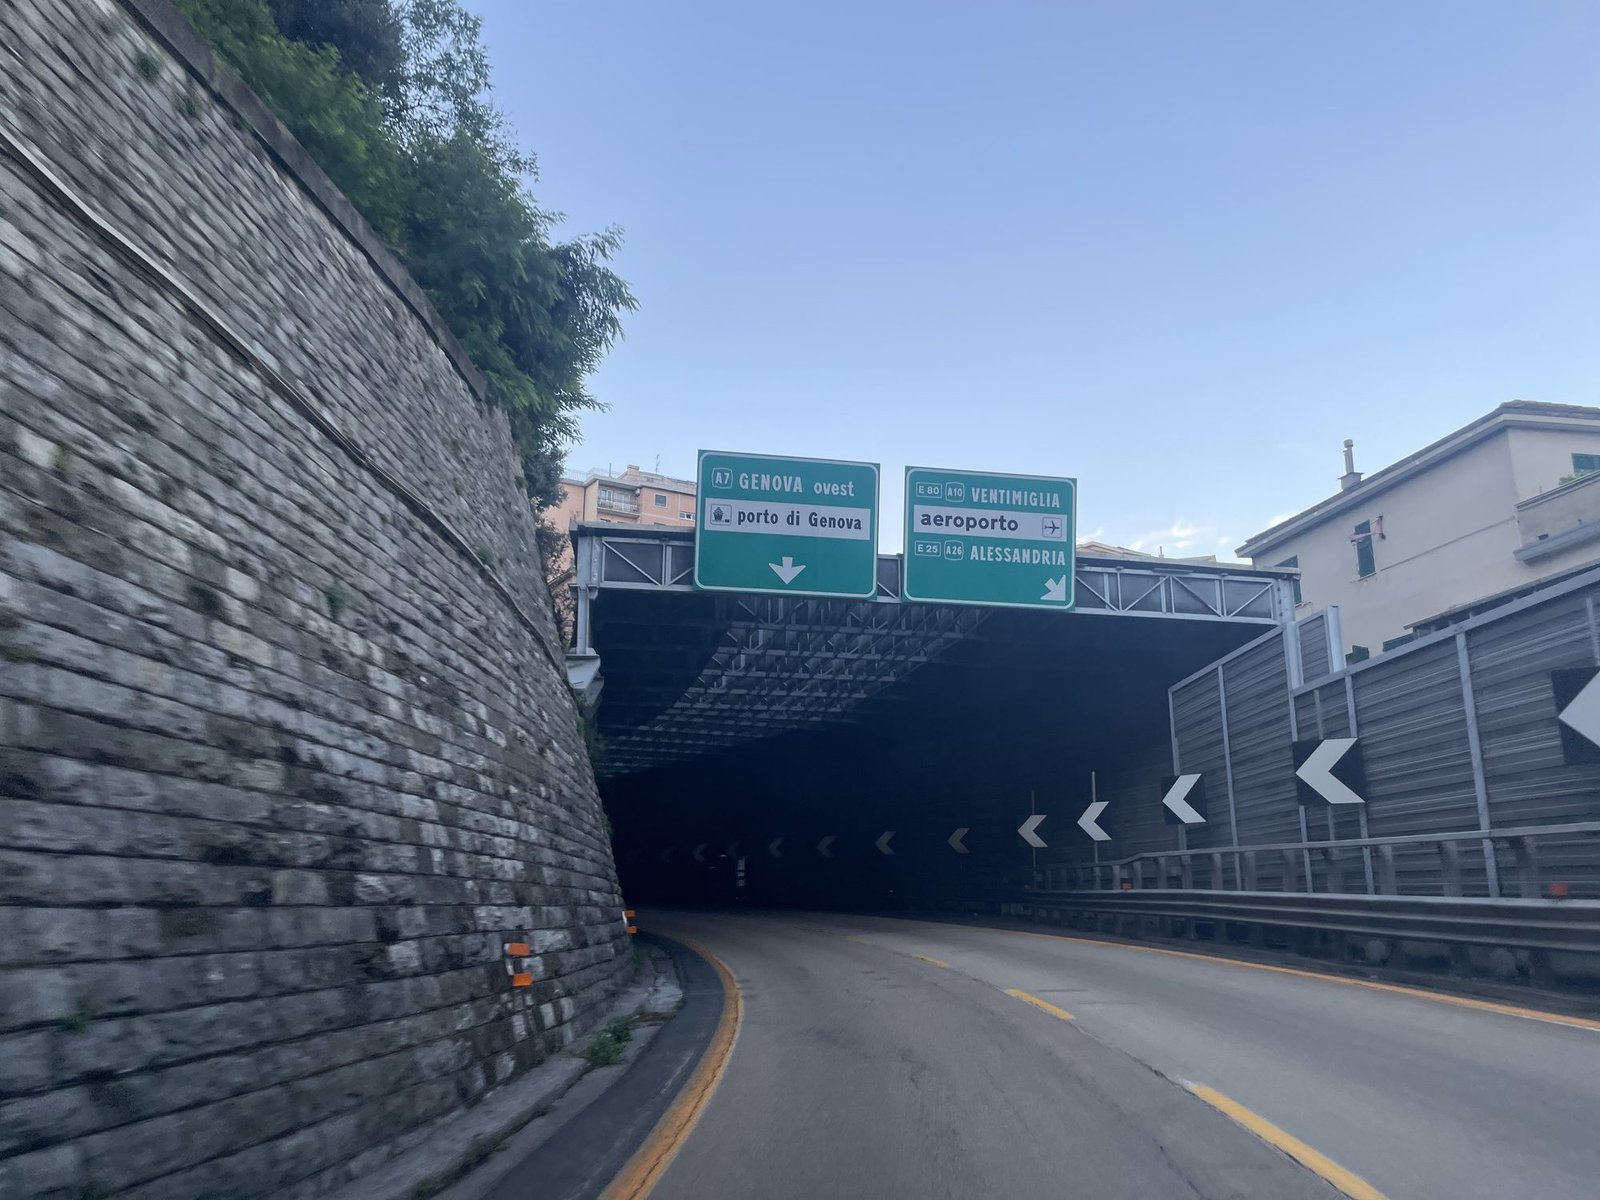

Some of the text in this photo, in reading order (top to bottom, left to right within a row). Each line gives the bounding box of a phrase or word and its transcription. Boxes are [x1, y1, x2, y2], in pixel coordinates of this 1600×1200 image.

[716, 472, 854, 496] A7 GENOVA ovest
[918, 485, 1060, 508] E 80 A10 VENTIMIGLIA
[738, 509, 862, 530] porto di Genova
[920, 513, 1018, 531] aeroporto
[917, 544, 923, 553] E
[926, 545, 938, 553] 25
[970, 545, 1065, 566] ALESSANDRIA
